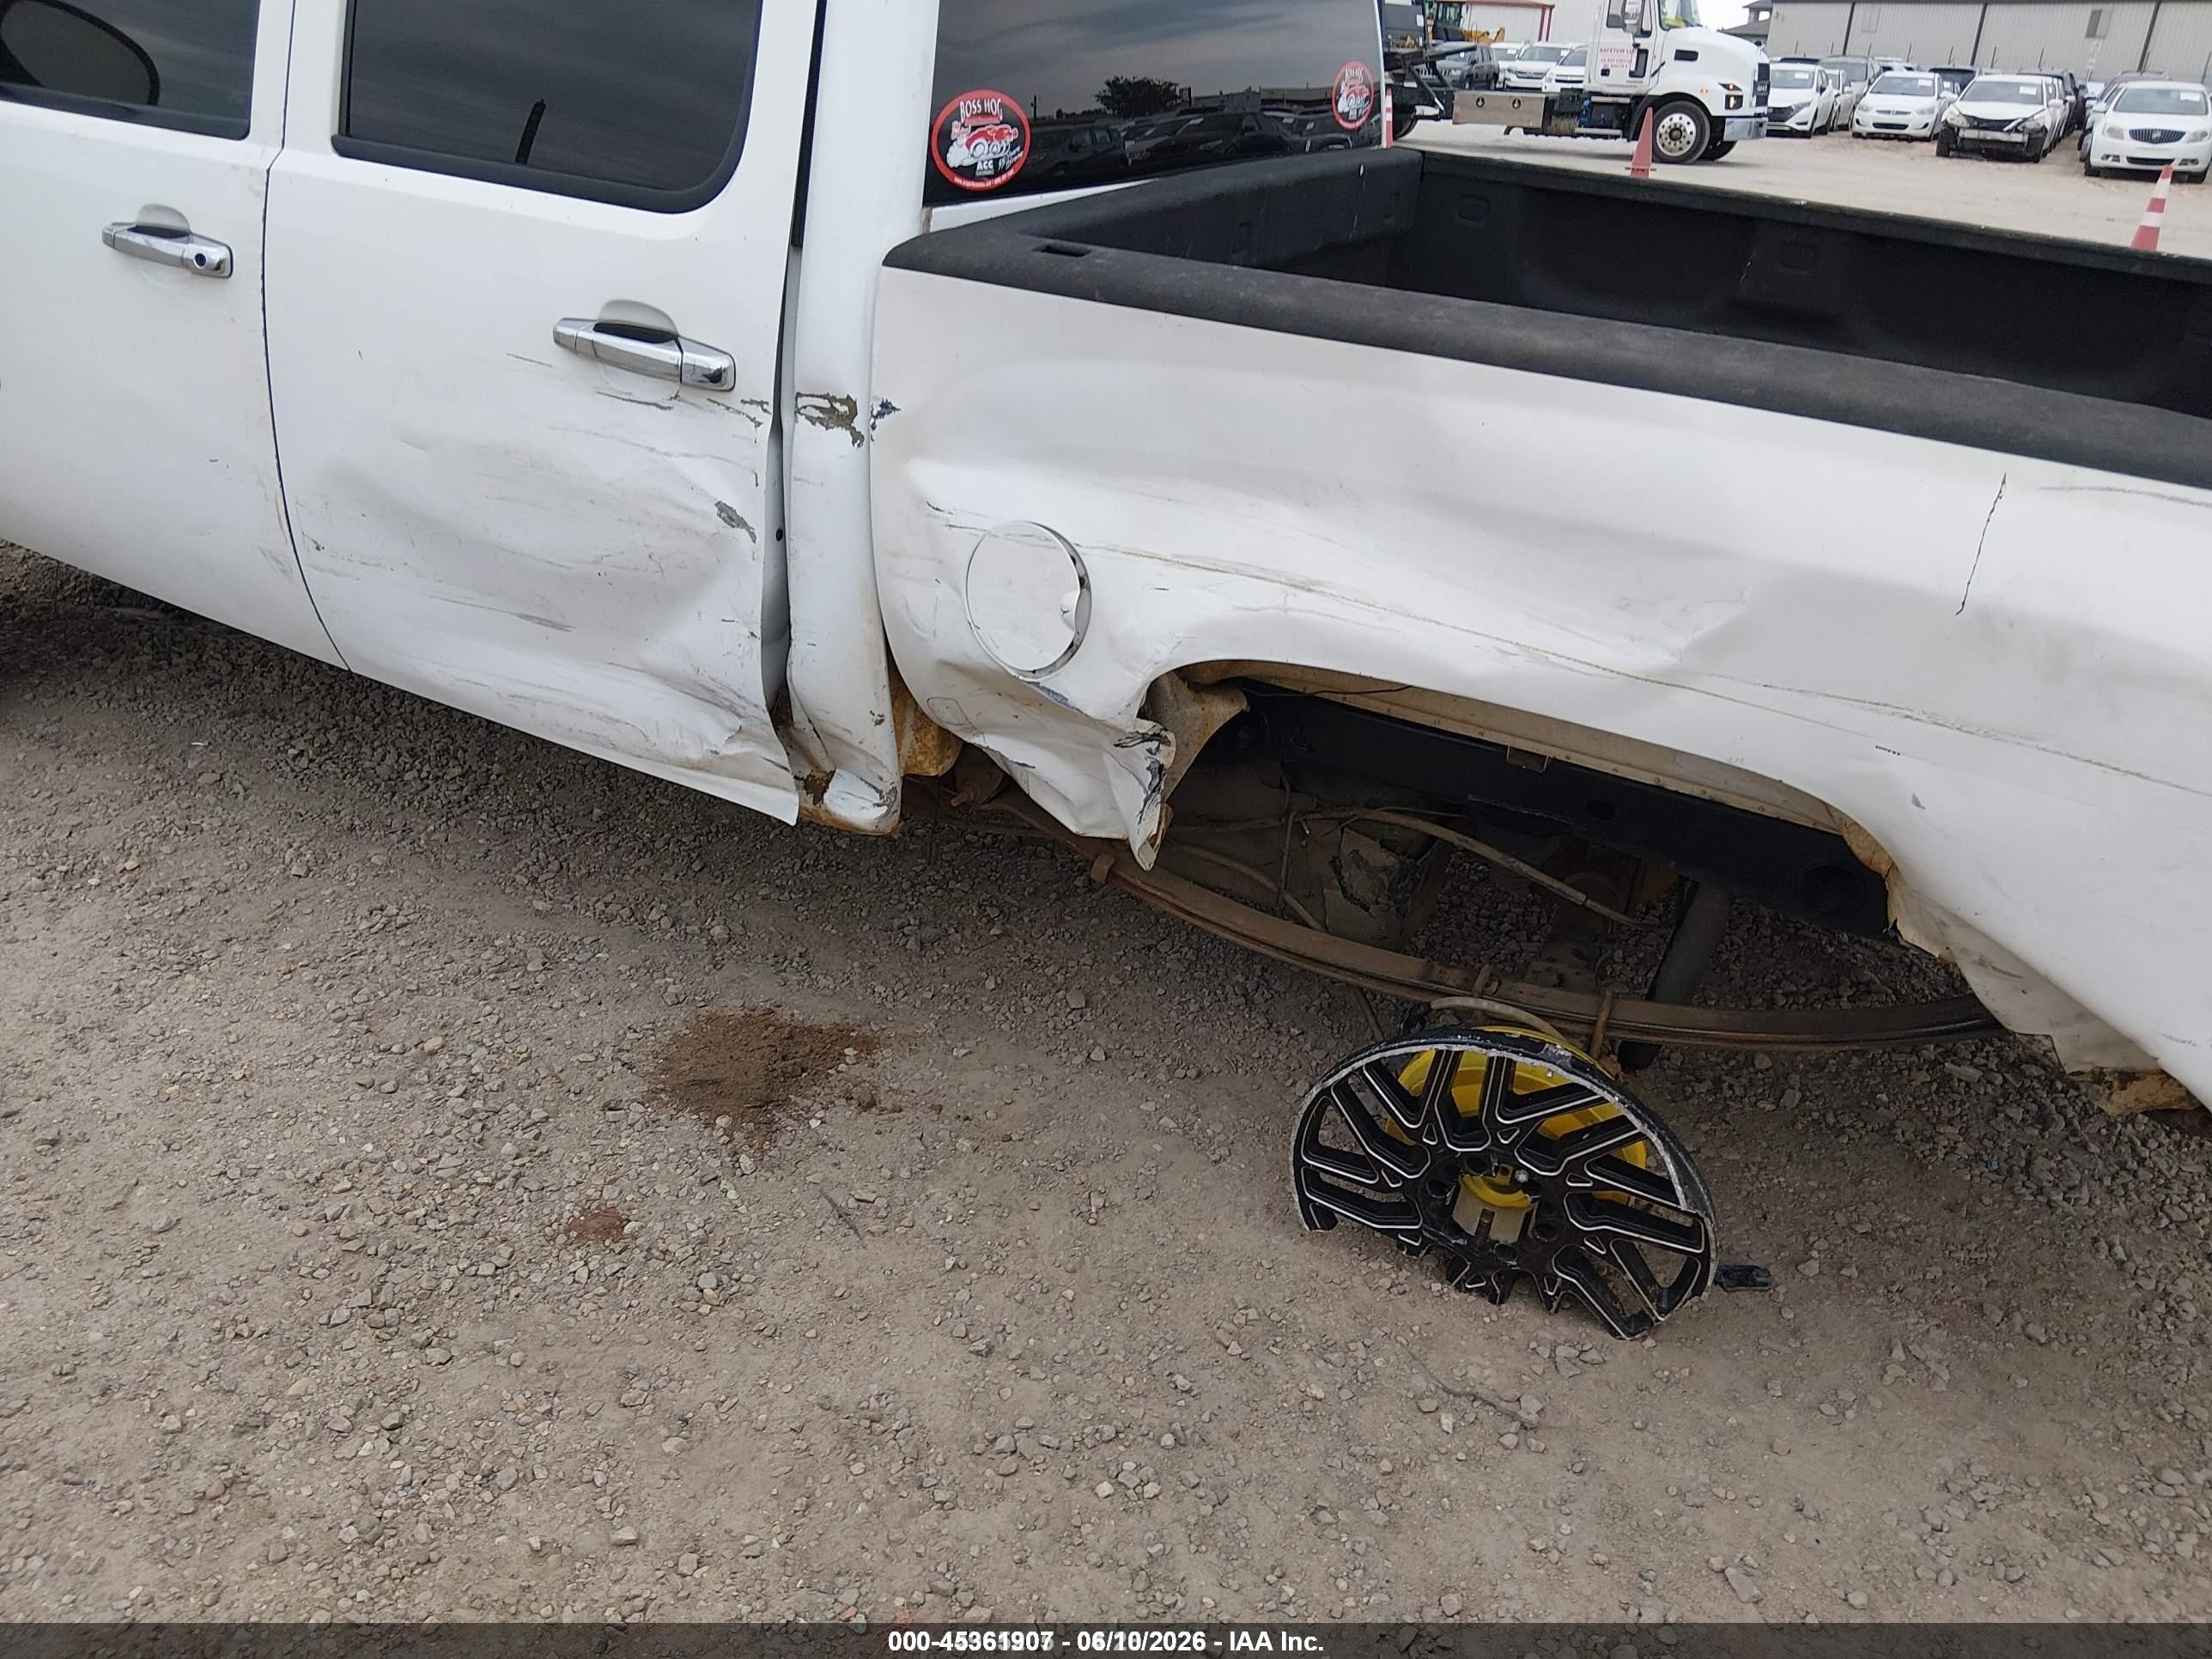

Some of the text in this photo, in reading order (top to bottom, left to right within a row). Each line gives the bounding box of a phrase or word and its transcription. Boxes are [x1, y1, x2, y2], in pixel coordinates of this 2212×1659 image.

[960, 99, 982, 125] BOSS
[984, 97, 1003, 122] HOG
[976, 160, 994, 171] ACC
